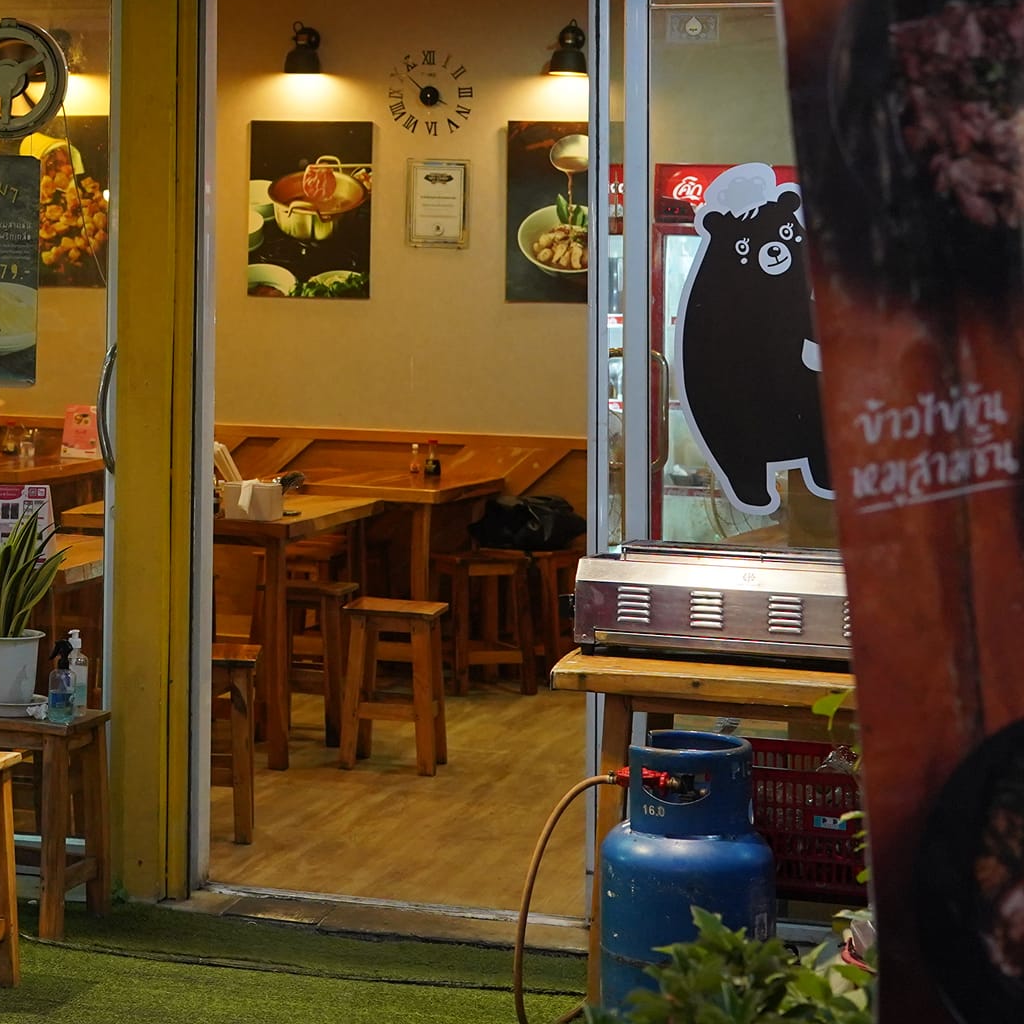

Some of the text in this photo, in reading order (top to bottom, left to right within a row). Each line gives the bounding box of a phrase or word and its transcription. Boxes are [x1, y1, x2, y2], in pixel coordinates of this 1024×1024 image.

[422, 50, 436, 66] XII
[450, 64, 467, 81] II
[458, 86, 474, 99] III
[388, 100, 407, 122] VIII
[455, 103, 472, 121] IV
[402, 113, 419, 134] VII
[424, 120, 438, 137] VI
[0, 263, 31, 280] 79.-
